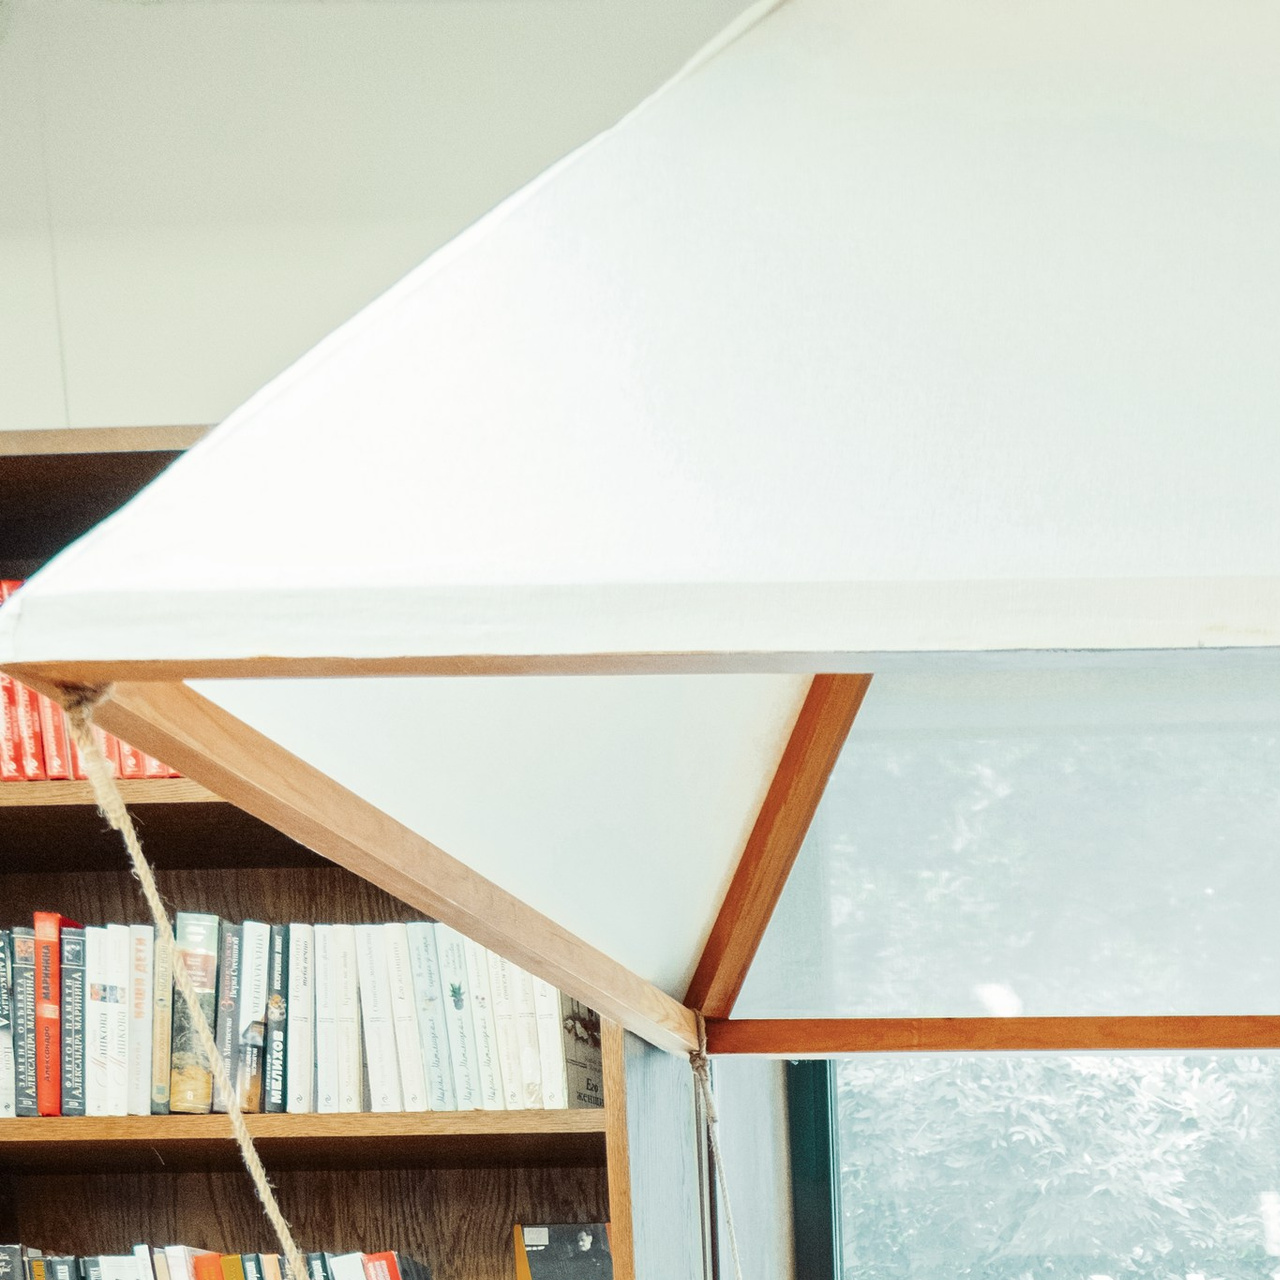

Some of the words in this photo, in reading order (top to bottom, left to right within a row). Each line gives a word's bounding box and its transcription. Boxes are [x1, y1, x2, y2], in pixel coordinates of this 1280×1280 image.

[24, 972, 34, 1029] МАРИНИНА
[42, 945, 50, 1000] МАРИНИНА
[71, 972, 82, 1030] МАРИНИНА
[25, 1034, 35, 1096] АЛЕКСАНДРА
[65, 1036, 73, 1088] ФАНТОМ
[72, 1034, 82, 1097] АЛЕКСАНДРА
[271, 1030, 283, 1103] МЕЛИХОВ
